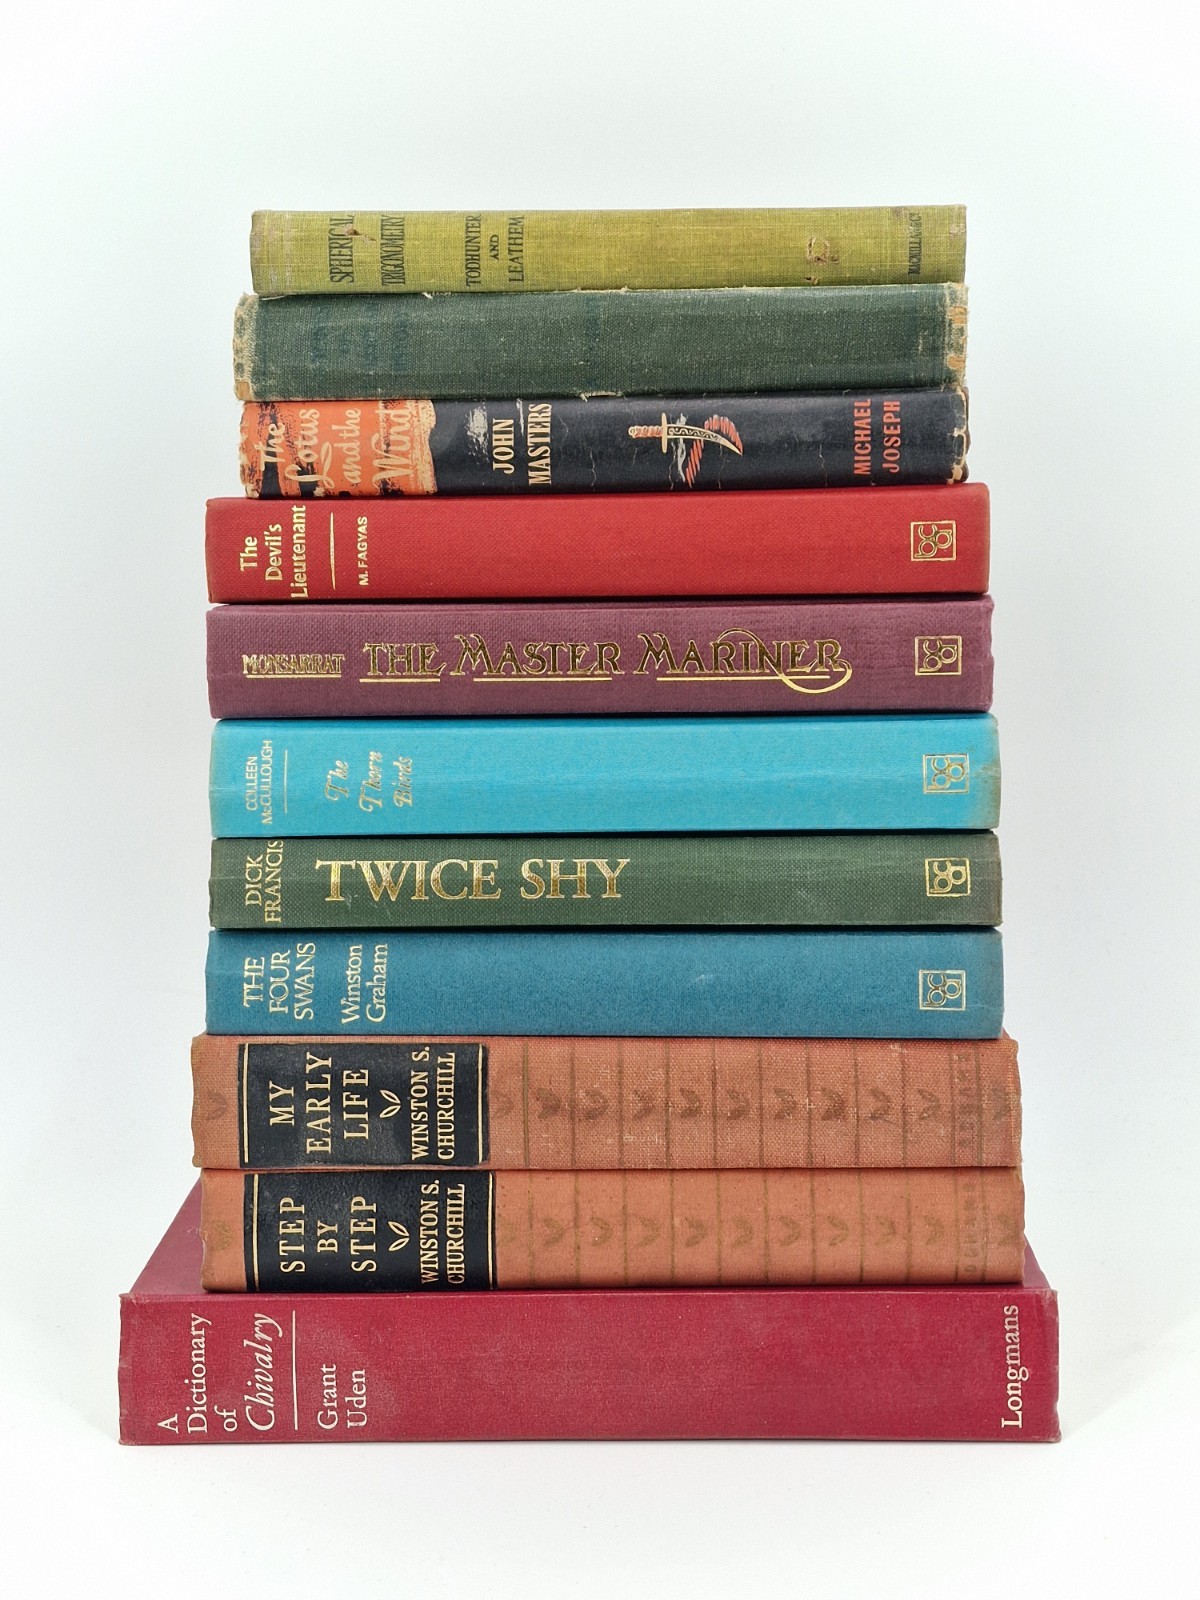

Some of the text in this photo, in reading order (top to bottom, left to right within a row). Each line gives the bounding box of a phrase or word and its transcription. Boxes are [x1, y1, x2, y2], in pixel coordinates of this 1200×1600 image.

[328, 215, 355, 284] SPHERICAL
[381, 214, 406, 286] TRIGONOMETRY
[465, 214, 482, 286] TODHUNTER
[490, 234, 500, 260] AND
[508, 216, 525, 283] LEATHEM
[252, 422, 286, 471] The
[285, 408, 335, 489] Lotus
[332, 408, 362, 484] and the
[371, 406, 411, 490] Wind
[493, 418, 515, 475] JOHN
[527, 403, 552, 486] MASTERS
[853, 398, 872, 476] MICHAEL
[881, 400, 901, 473] JOSEPH
[239, 536, 258, 572] The
[264, 523, 283, 581] Devil's
[290, 504, 309, 599] Lieutenant
[357, 516, 369, 586] M. FAGYAS
[241, 654, 345, 675] MONSARRAT
[362, 627, 853, 694] THE MASTER MARINER
[245, 756, 258, 811] COLLEEN
[260, 740, 273, 825] McCULLOUGH
[324, 760, 349, 801] The
[359, 751, 383, 813] Thorn
[392, 756, 413, 808] Birds
[245, 854, 264, 907] DICK
[264, 840, 284, 924] FRANCIS
[315, 858, 630, 901] TWICE SHY
[243, 956, 265, 1008] THE
[269, 950, 291, 1014] FOUR
[294, 942, 316, 1020] SWANS
[340, 944, 363, 1024] Winston
[365, 943, 388, 1023] Graham
[269, 1080, 295, 1127] MY
[305, 1052, 332, 1154] EARLY
[343, 1068, 369, 1140] LIFE
[410, 1046, 430, 1161] WINSTON S.
[437, 1052, 455, 1161] CHURCHILL
[279, 1197, 306, 1273] STEP
[316, 1220, 338, 1253] BY
[350, 1196, 377, 1272] STEP
[420, 1179, 440, 1285] WINSTON S.
[446, 1183, 465, 1285] CHURCHILL
[184, 1312, 212, 1434] Dictionary
[243, 1312, 283, 1431] Chivalry
[317, 1363, 339, 1430] Grant
[344, 1368, 367, 1429] Uden
[1001, 1304, 1029, 1429] Longmans
[157, 1413, 179, 1434] A
[214, 1405, 238, 1432] of
